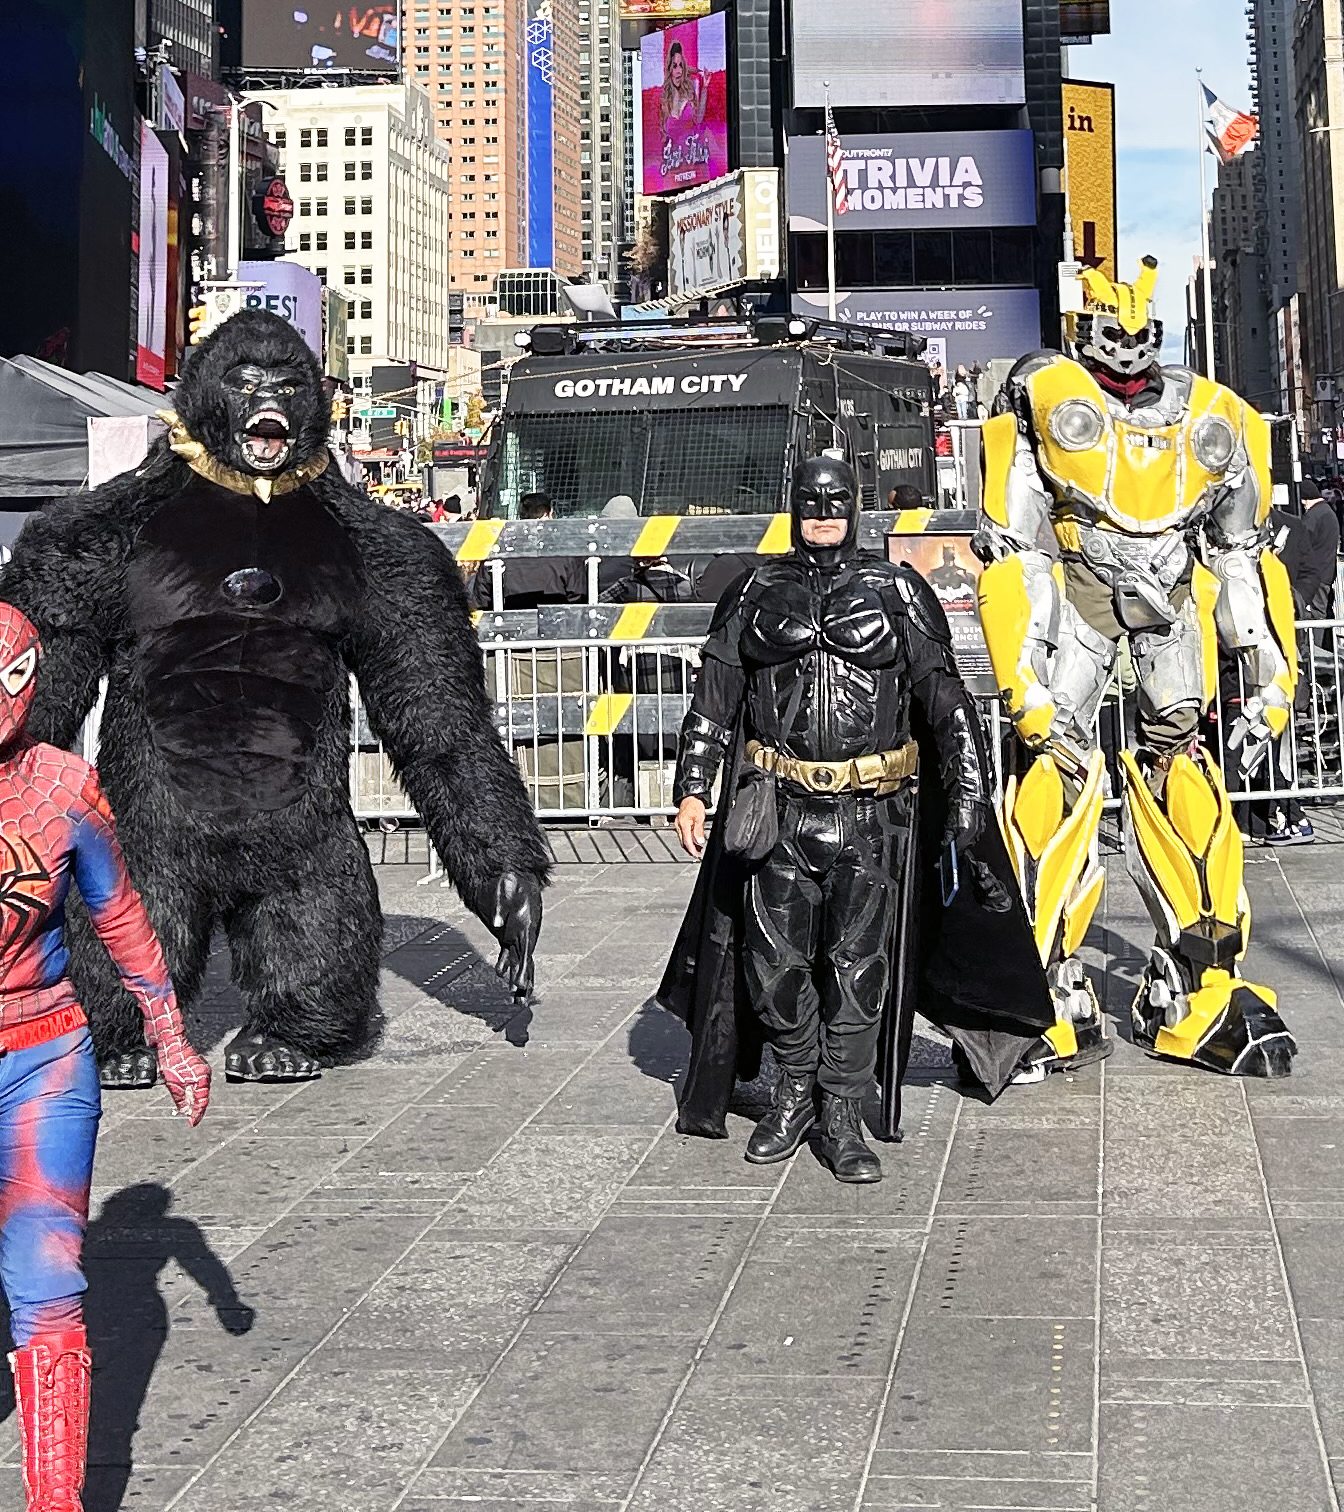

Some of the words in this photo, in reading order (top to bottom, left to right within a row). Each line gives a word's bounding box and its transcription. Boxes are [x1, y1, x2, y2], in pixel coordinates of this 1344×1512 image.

[1067, 106, 1095, 133] in
[841, 157, 983, 189] TRIVIA
[848, 186, 984, 210] MOMENTS
[857, 311, 883, 321] PLAY
[884, 311, 898, 320] TO
[899, 311, 918, 320] WIN
[929, 310, 957, 320] WEEK
[959, 310, 973, 319] OF
[896, 322, 910, 330] OR
[912, 321, 954, 330] SUBWAY
[956, 321, 986, 330] RIDES
[554, 376, 676, 399] GOTHAM
[680, 373, 749, 396] CITY
[879, 448, 909, 471] GOTHAM
[908, 447, 923, 468] CITY
